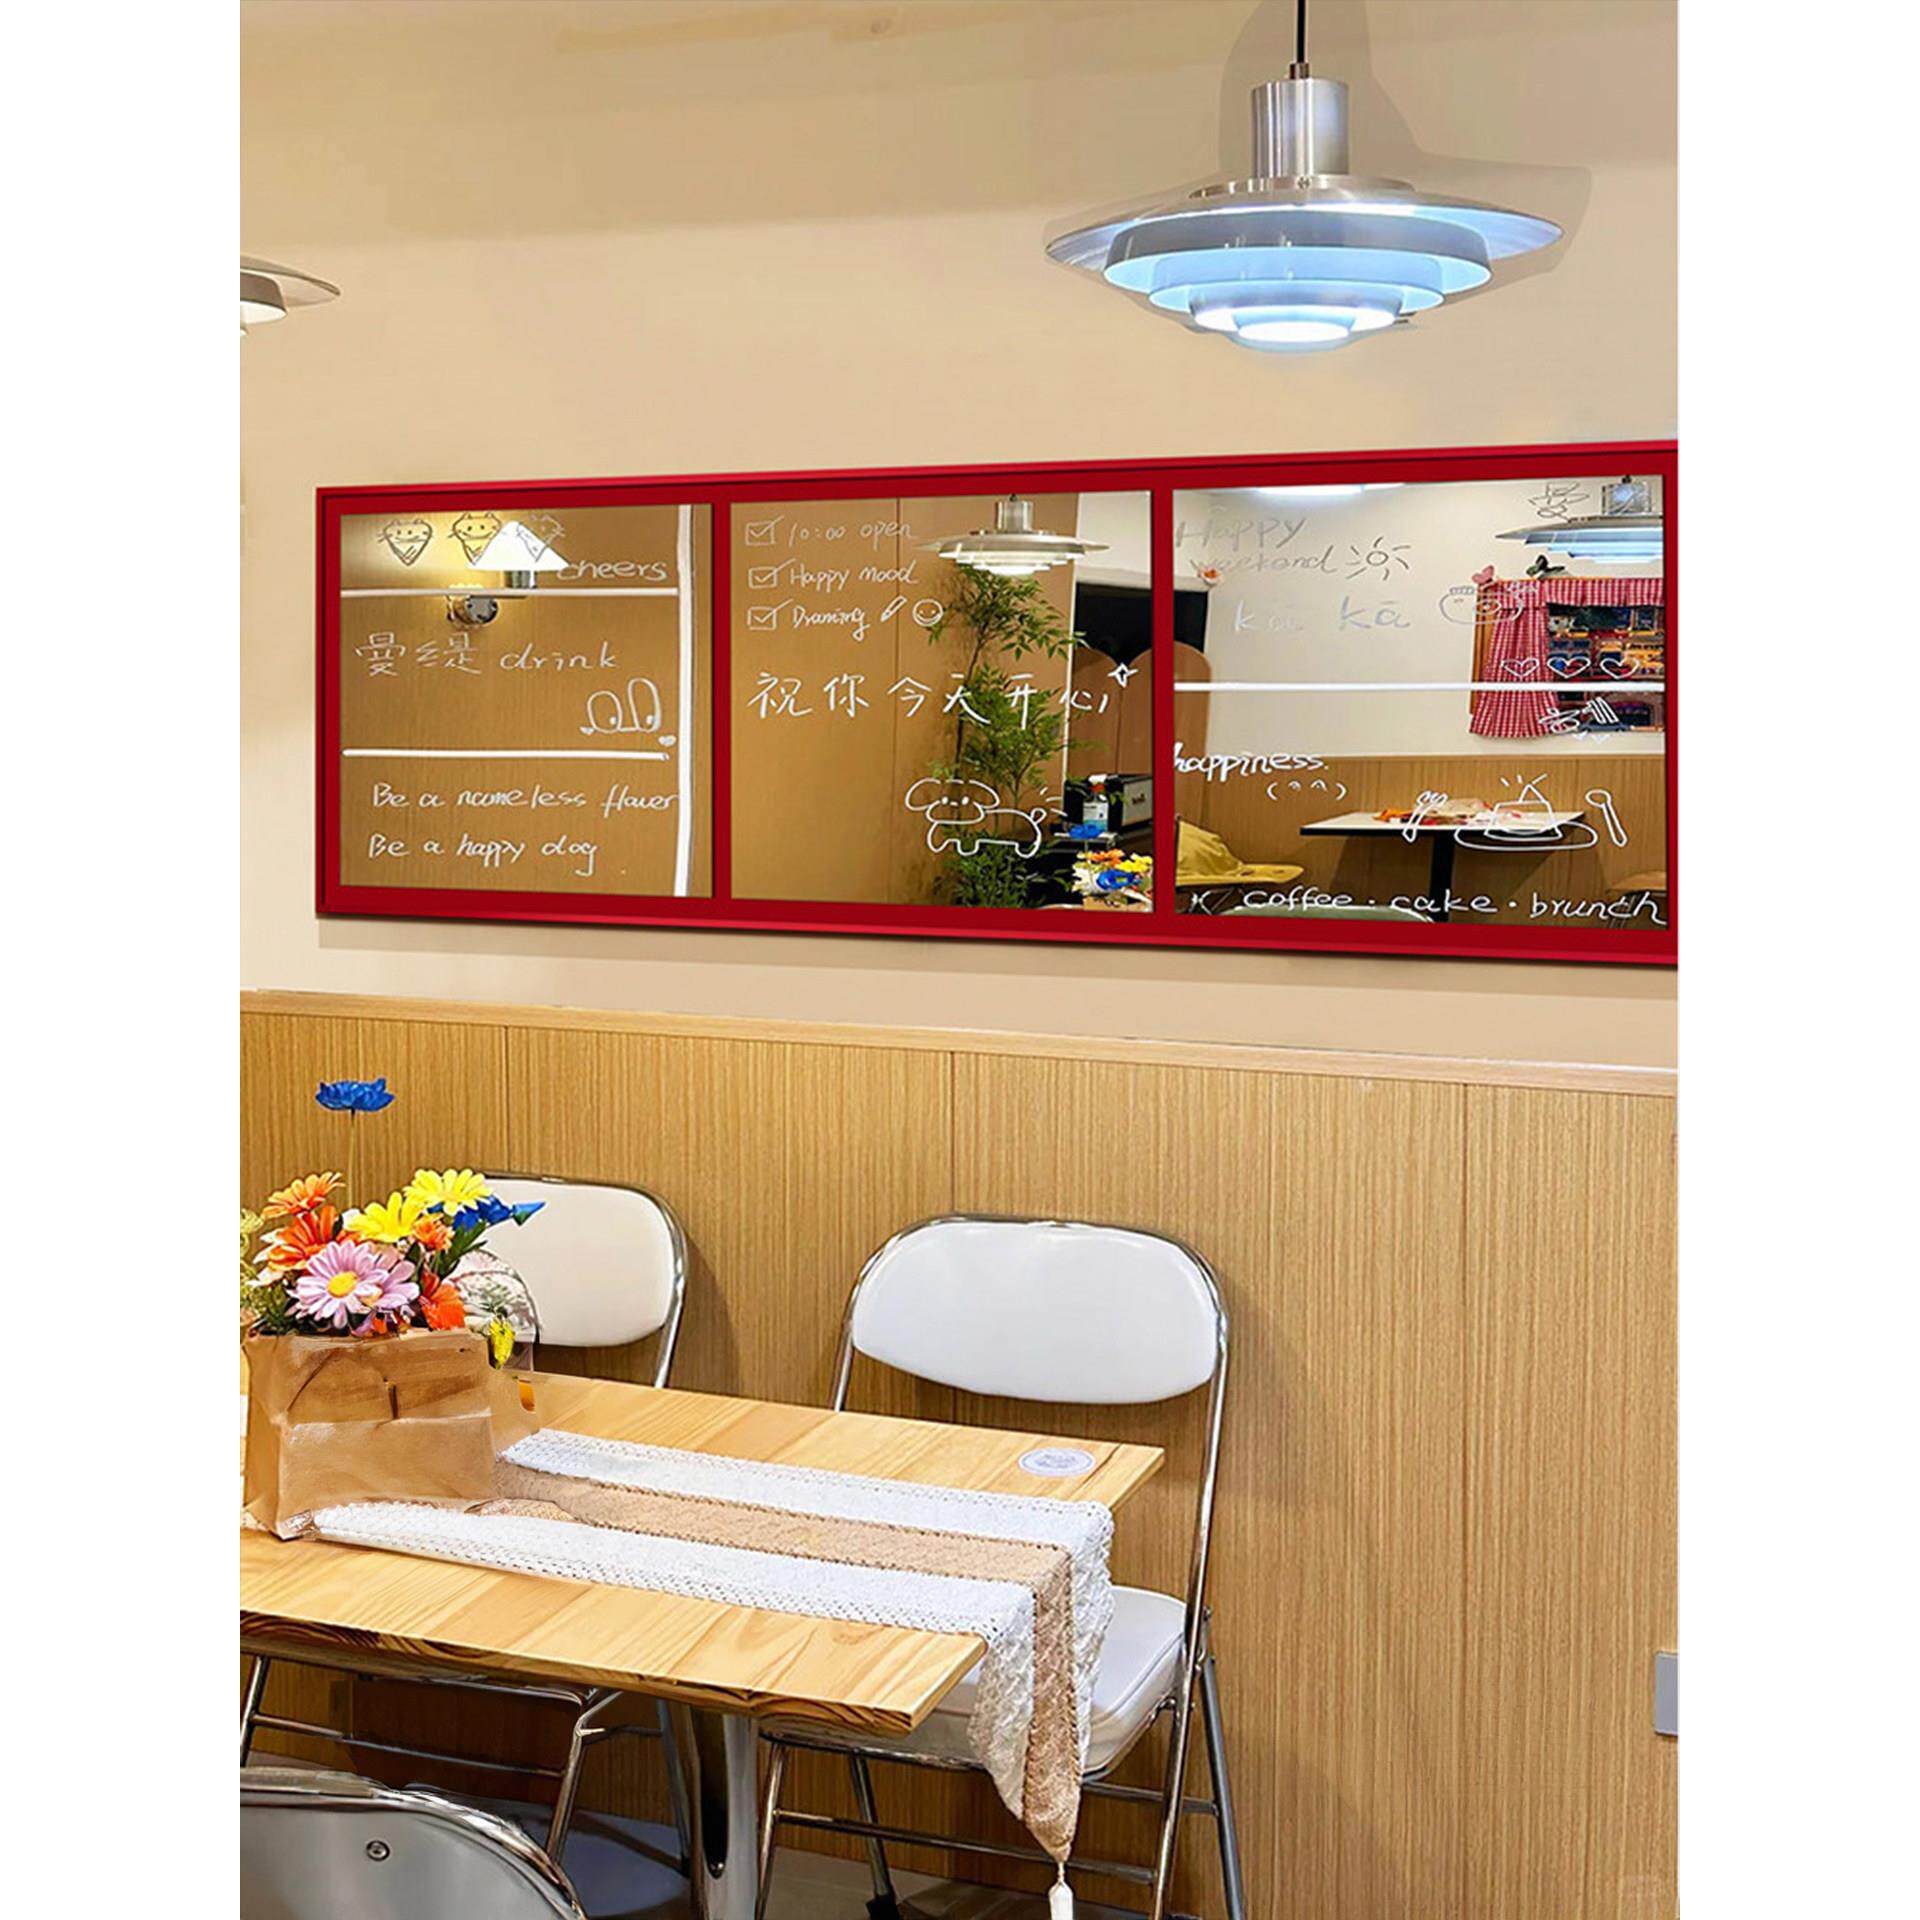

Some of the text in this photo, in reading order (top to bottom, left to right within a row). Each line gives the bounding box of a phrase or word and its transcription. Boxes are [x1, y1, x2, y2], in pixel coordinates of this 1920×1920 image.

[860, 520, 918, 550] open
[1175, 518, 1306, 551] Happy
[556, 560, 667, 581] cheers
[790, 559, 918, 592] Happy mood
[500, 641, 618, 671] drink
[750, 672, 1108, 729] 祝你今天开心
[373, 782, 410, 808] Be
[418, 791, 446, 807] a
[368, 833, 598, 877] Be a happy dog
[1391, 889, 1498, 913] cake
[1529, 891, 1668, 926] brunch
